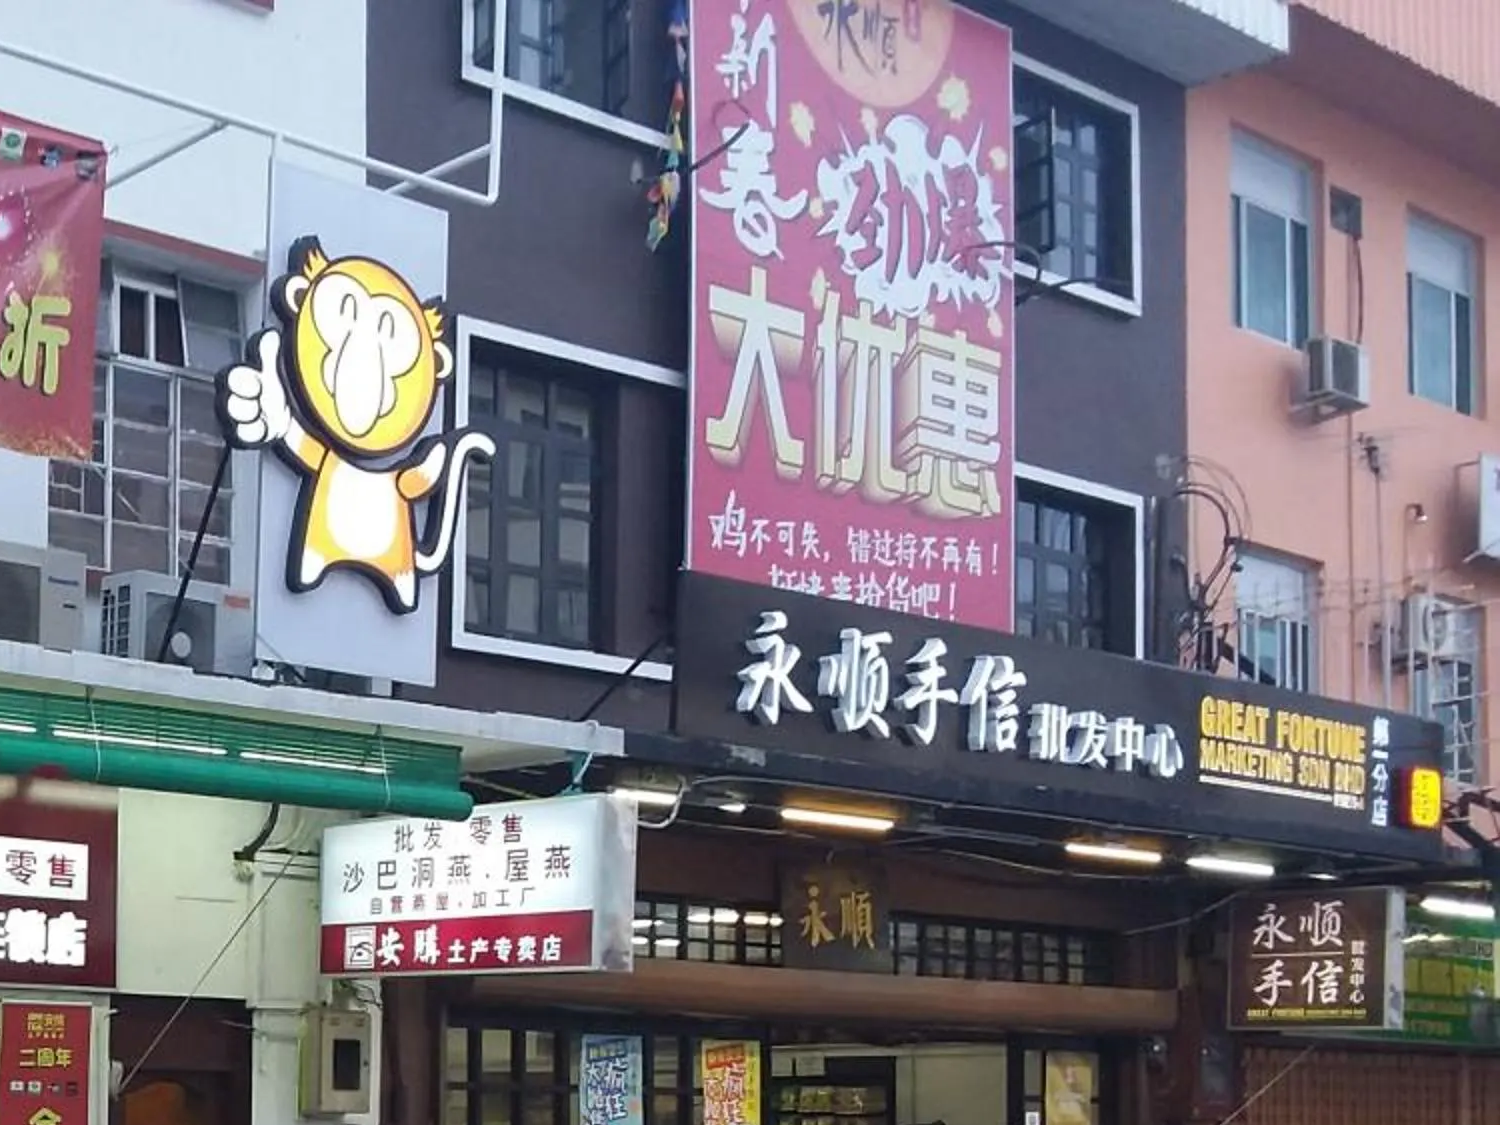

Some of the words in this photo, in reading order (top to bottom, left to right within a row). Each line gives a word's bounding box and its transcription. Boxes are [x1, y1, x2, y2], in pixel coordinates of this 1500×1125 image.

[699, 0, 809, 261] 新春
[705, 266, 1001, 518] 大优惠
[736, 609, 1028, 752] 永顺手信
[1027, 701, 1185, 778] 批发中心
[1201, 695, 1270, 745] GREAT
[1276, 709, 1367, 764] FORTUNE
[1200, 736, 1293, 783] MARKETING
[1297, 754, 1331, 790] SDN
[799, 886, 875, 949] 永順
[1253, 901, 1345, 949] 永顺
[447, 933, 563, 964] 土产专卖店
[1253, 959, 1345, 1007] 手信
[19, 1047, 72, 1068] 二周年
